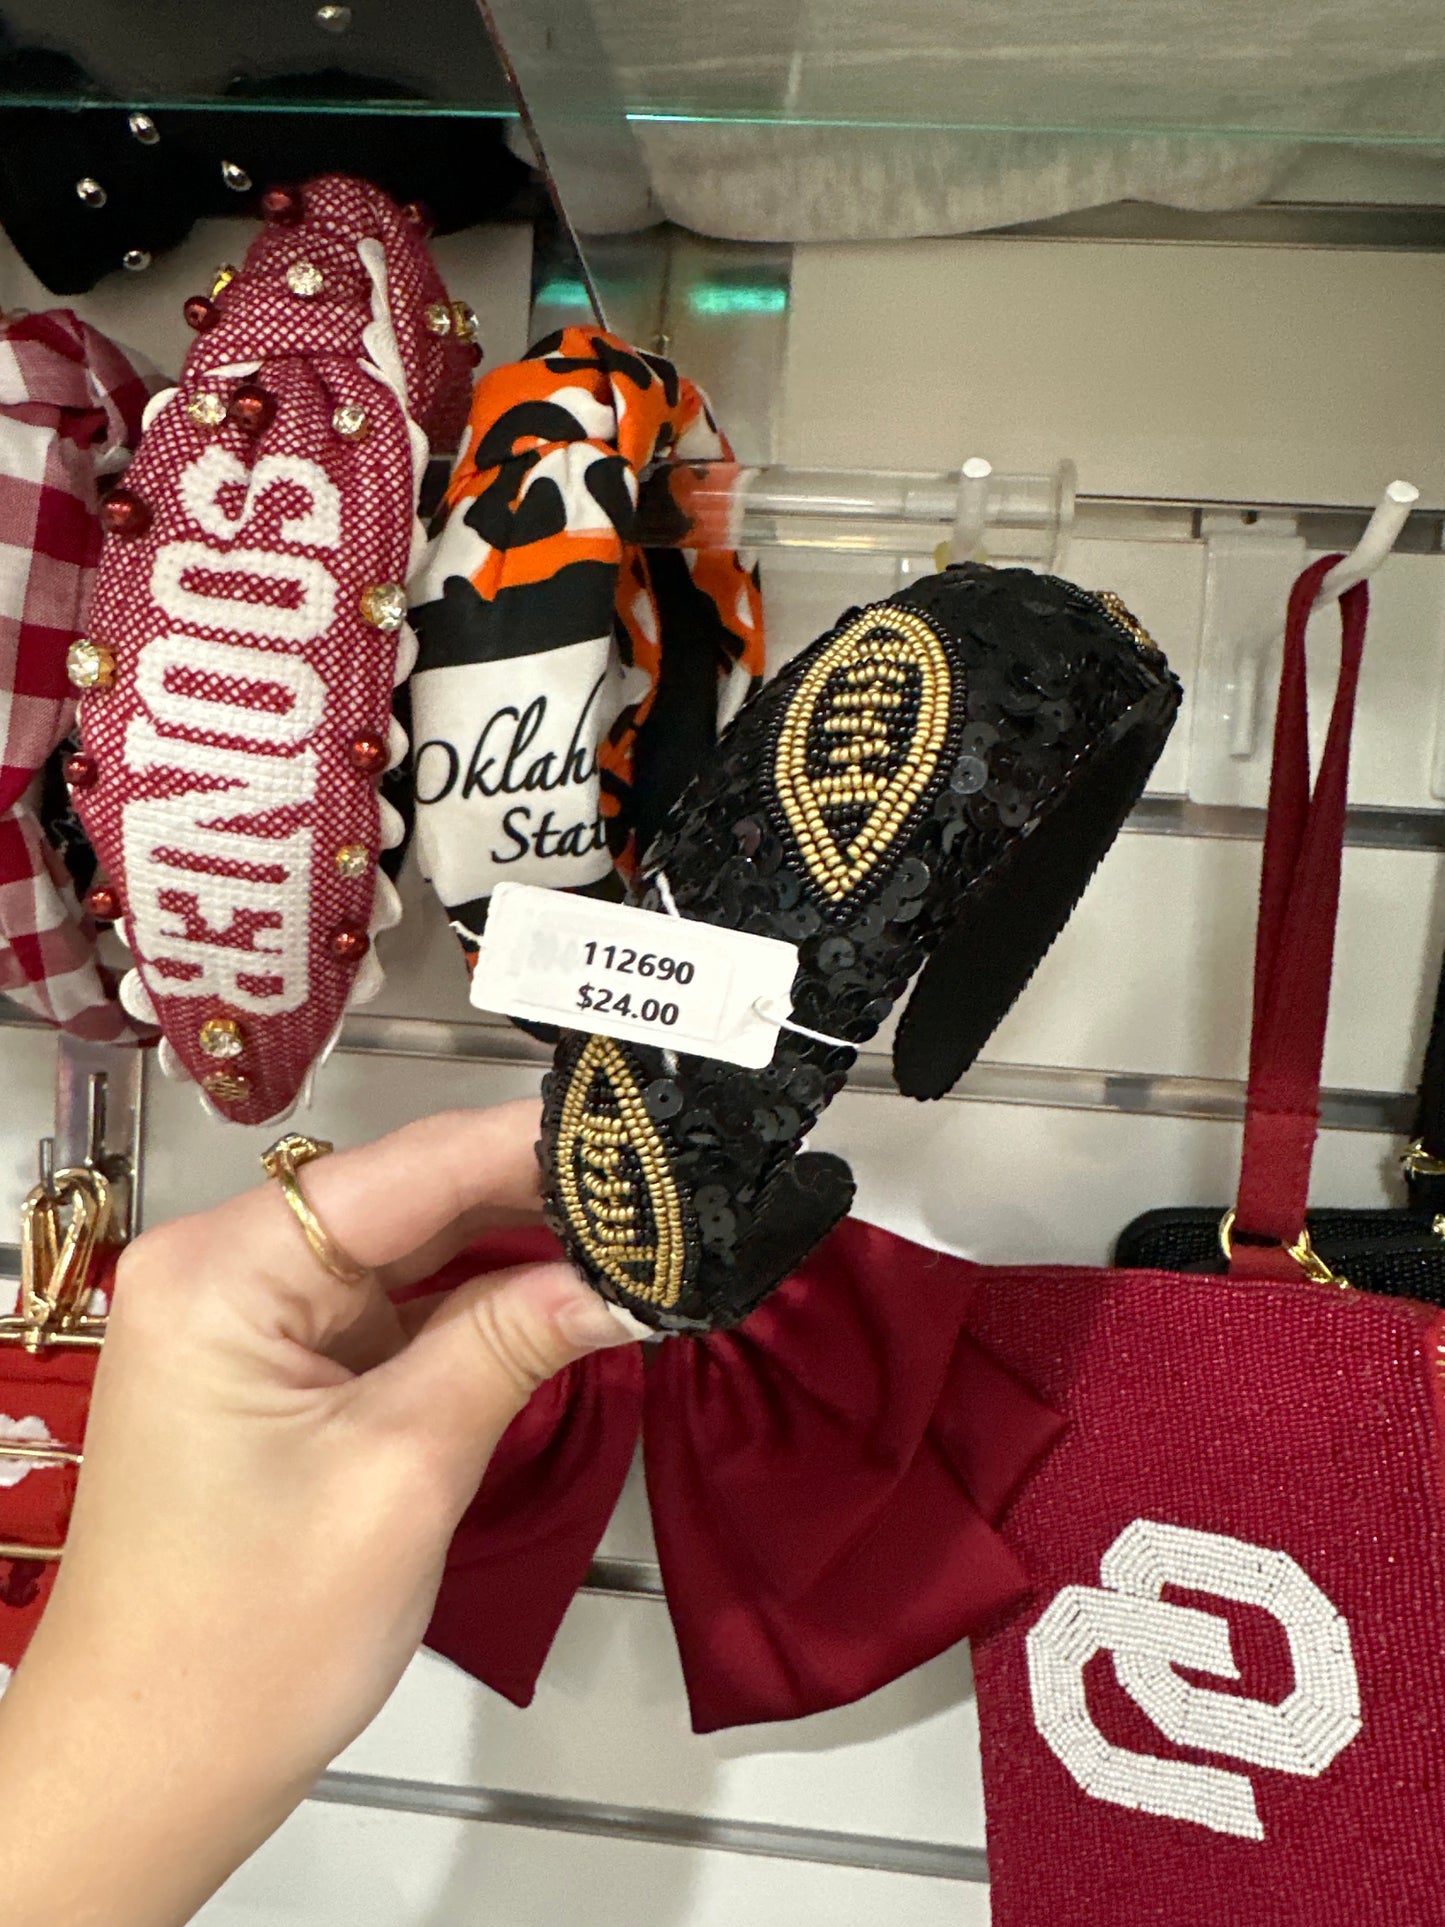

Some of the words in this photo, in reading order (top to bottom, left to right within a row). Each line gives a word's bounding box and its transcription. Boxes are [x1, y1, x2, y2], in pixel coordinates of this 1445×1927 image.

[122, 445, 342, 1017] SOONER
[414, 671, 606, 805] Oklah
[576, 982, 680, 1026] $24.00
[583, 941, 695, 985] 112690
